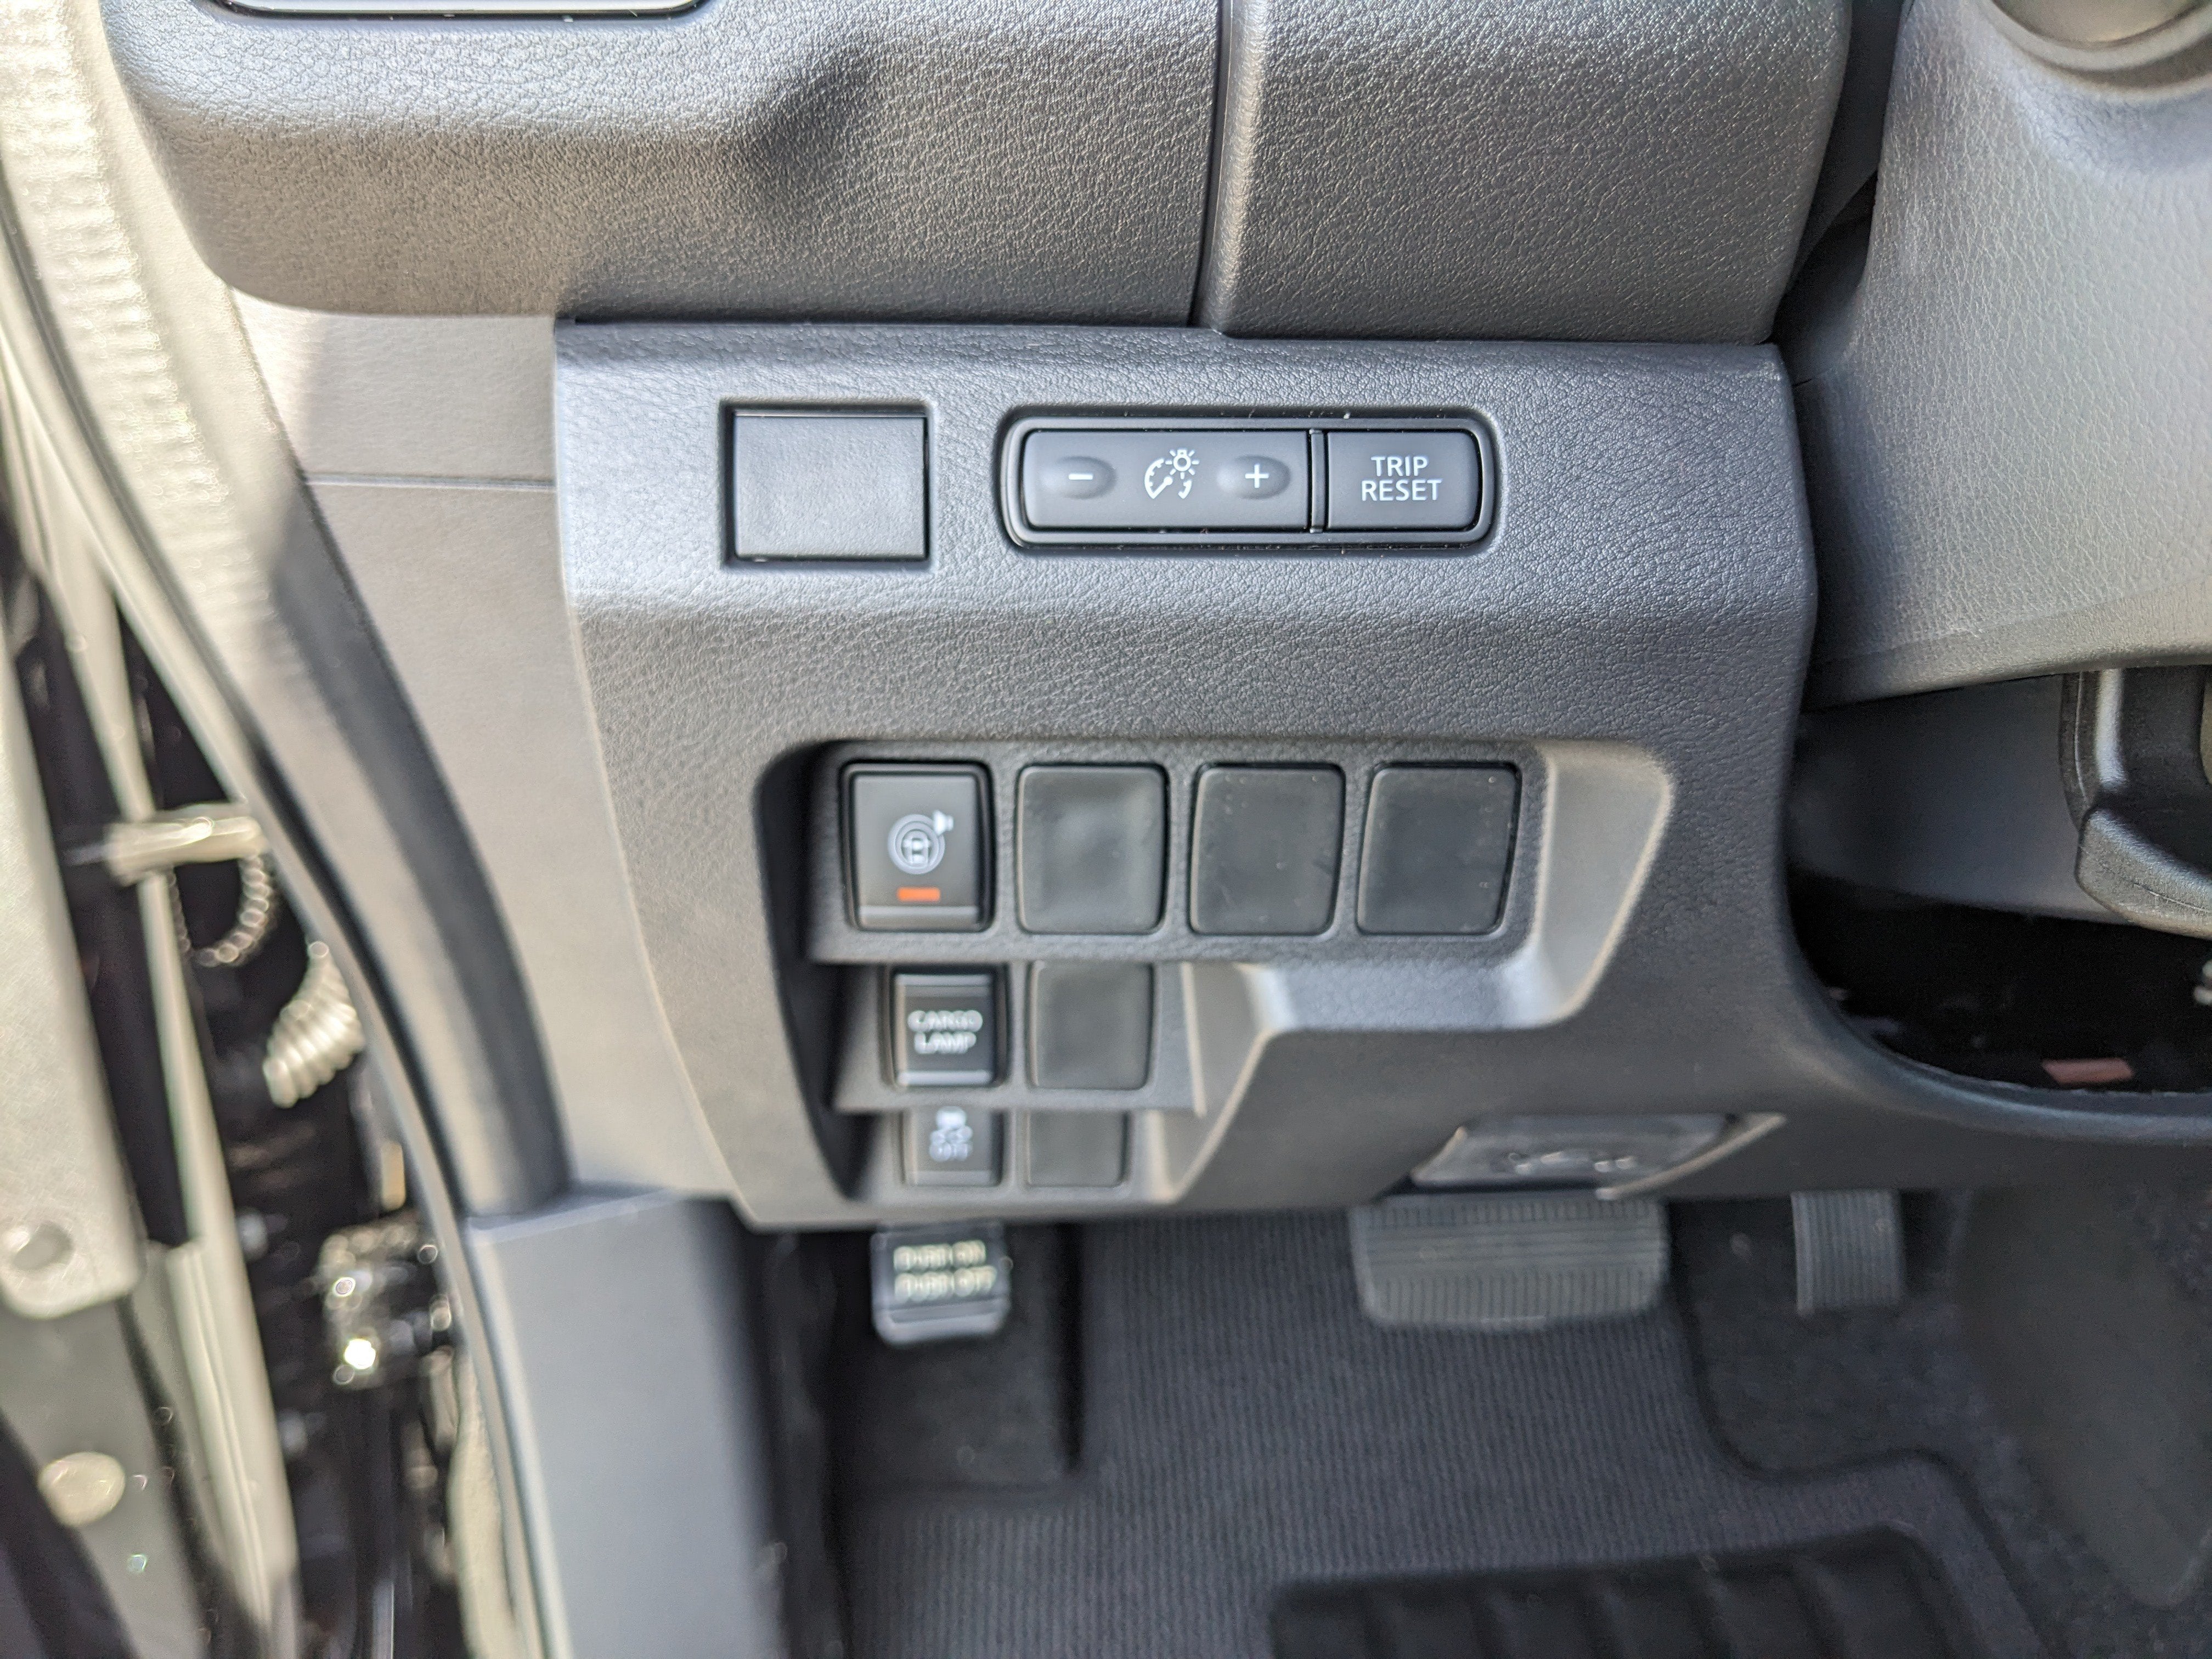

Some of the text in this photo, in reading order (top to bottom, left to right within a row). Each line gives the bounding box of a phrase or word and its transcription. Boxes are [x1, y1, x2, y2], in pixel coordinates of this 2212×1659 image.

[1370, 455, 1429, 477] TRIP
[1361, 478, 1443, 501] RESET
[908, 1009, 983, 1033] CARGO
[915, 1031, 977, 1054] LAMP
